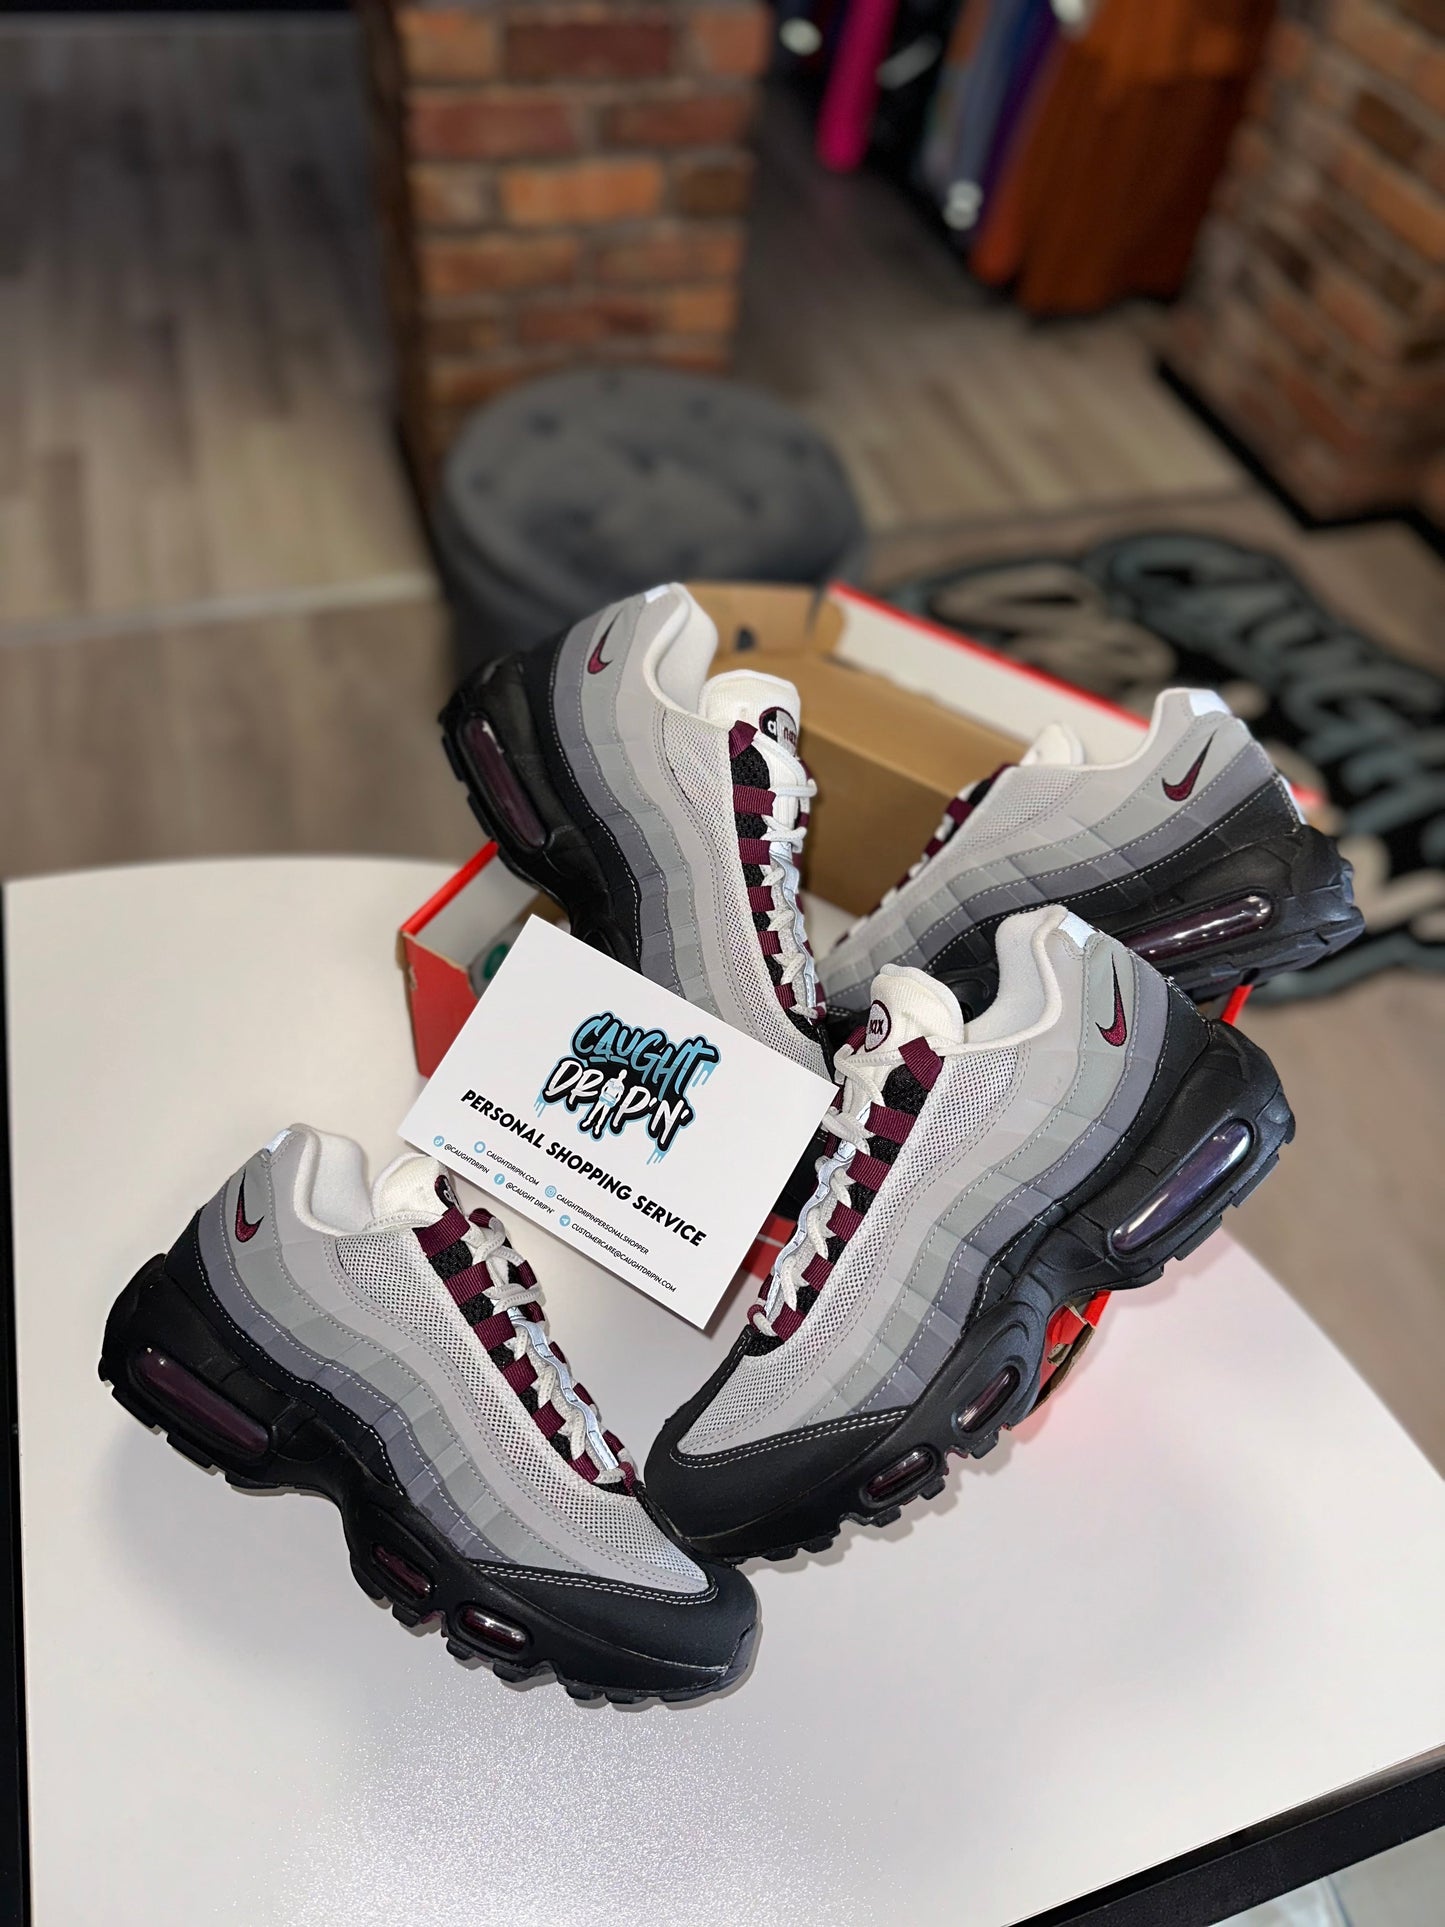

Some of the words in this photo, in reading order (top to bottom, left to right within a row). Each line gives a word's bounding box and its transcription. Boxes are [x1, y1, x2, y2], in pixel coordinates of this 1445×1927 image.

[572, 1011, 718, 1101] CAUGHT
[444, 1143, 490, 1174] @CAUGHTDRIPIN
[460, 1089, 547, 1149] PERSONAL
[545, 1141, 633, 1201] SHOPPING
[631, 1195, 707, 1247] SERVICE
[486, 1150, 540, 1186] CAUGHTDRIPIN.COM
[505, 1182, 535, 1203] @CAUGHT
[556, 1193, 650, 1255] CAUGHTDRIPINPERSONALSHOPPER
[571, 1222, 677, 1293] CUSTOMERCARE@CAUGHTDRIPIN.COM
